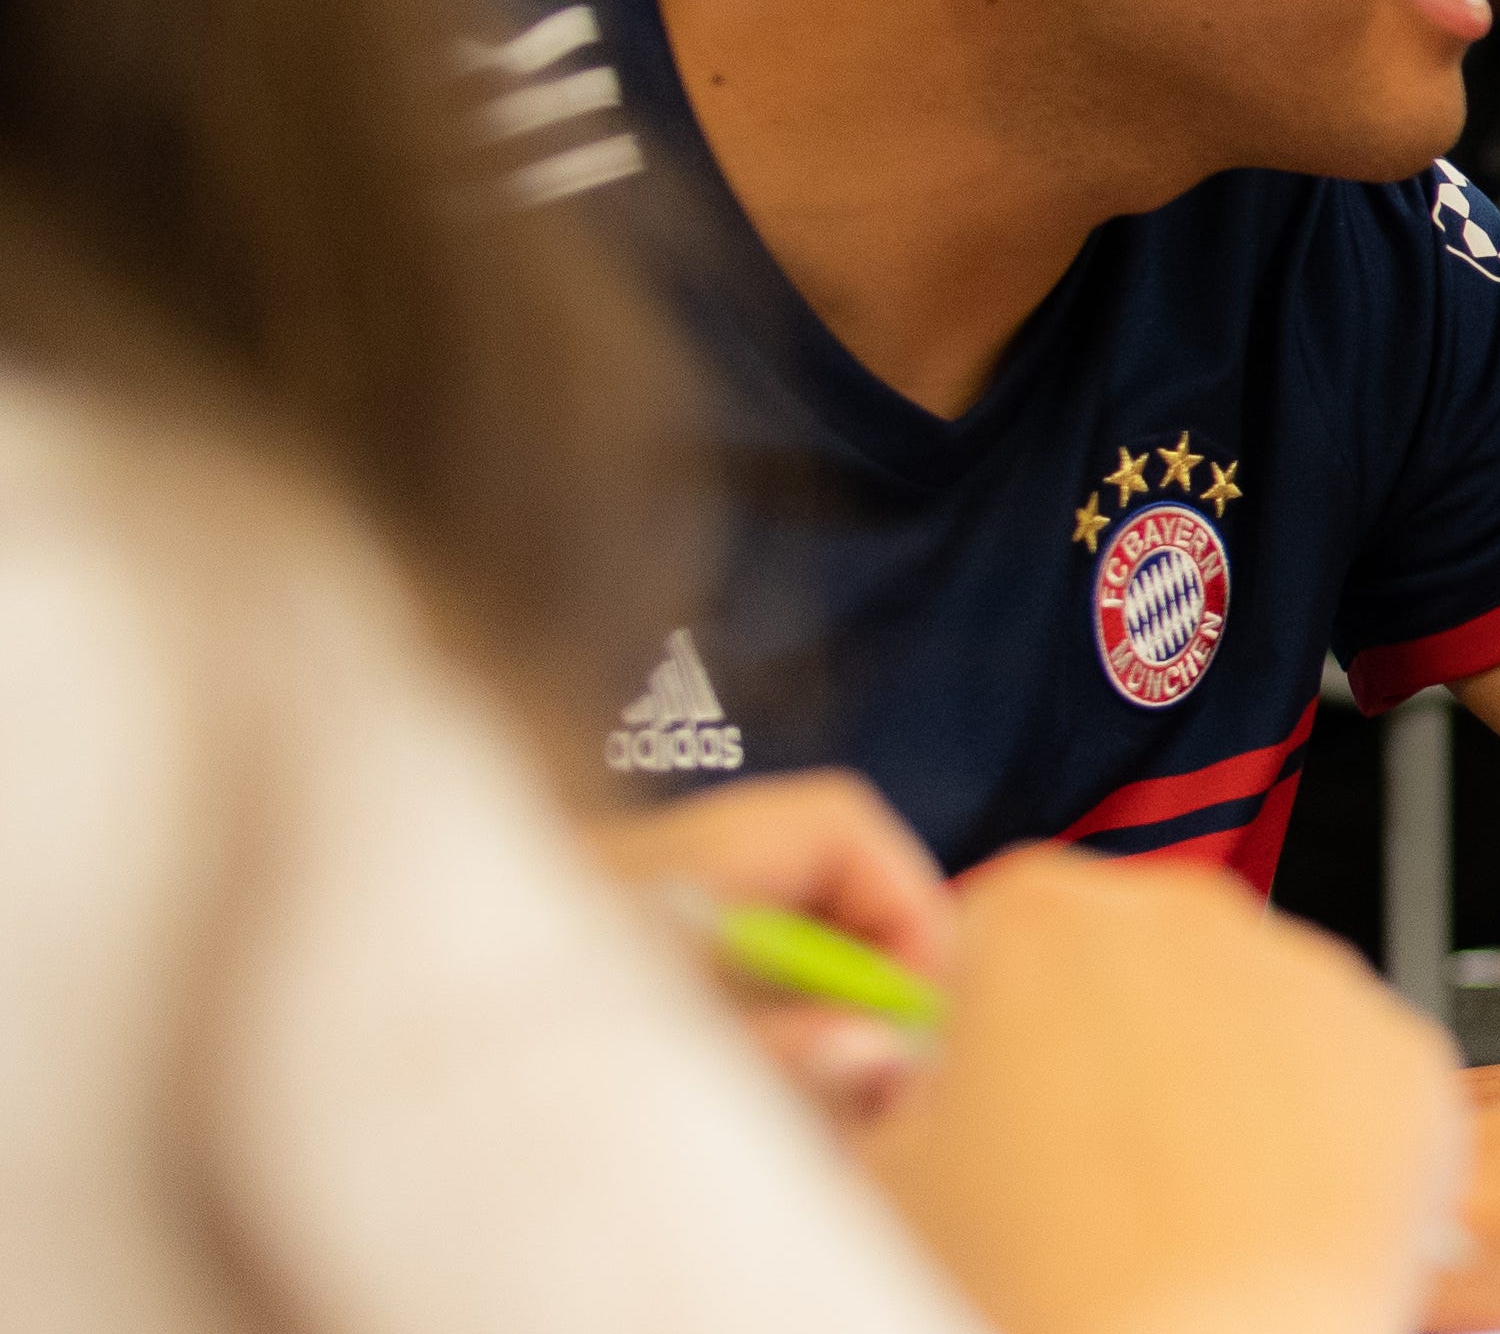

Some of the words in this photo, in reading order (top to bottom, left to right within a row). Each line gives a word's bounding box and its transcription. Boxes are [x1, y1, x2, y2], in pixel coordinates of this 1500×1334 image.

[1101, 556, 1130, 609] FC
[1122, 517, 1223, 582] BAYERN
[604, 718, 746, 771] adidas
